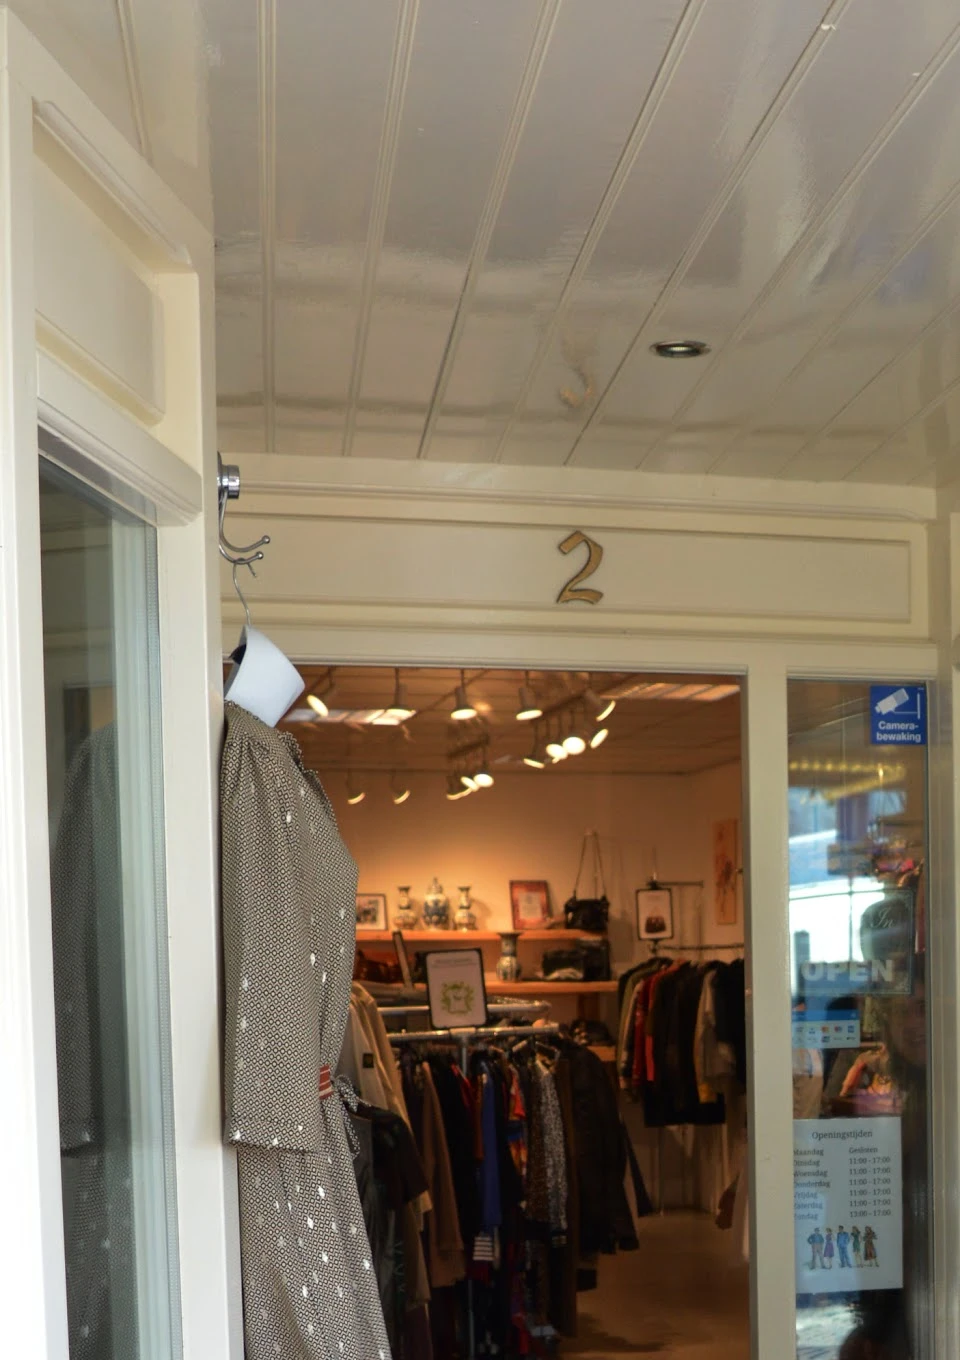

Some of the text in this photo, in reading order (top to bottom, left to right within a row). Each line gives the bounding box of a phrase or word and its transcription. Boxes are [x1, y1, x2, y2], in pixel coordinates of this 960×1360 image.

[556, 530, 604, 604] 2
[878, 721, 919, 730] Camera-
[876, 732, 921, 743] bewaking
[800, 960, 894, 982] OPEN
[811, 1130, 873, 1141] Openingstijden
